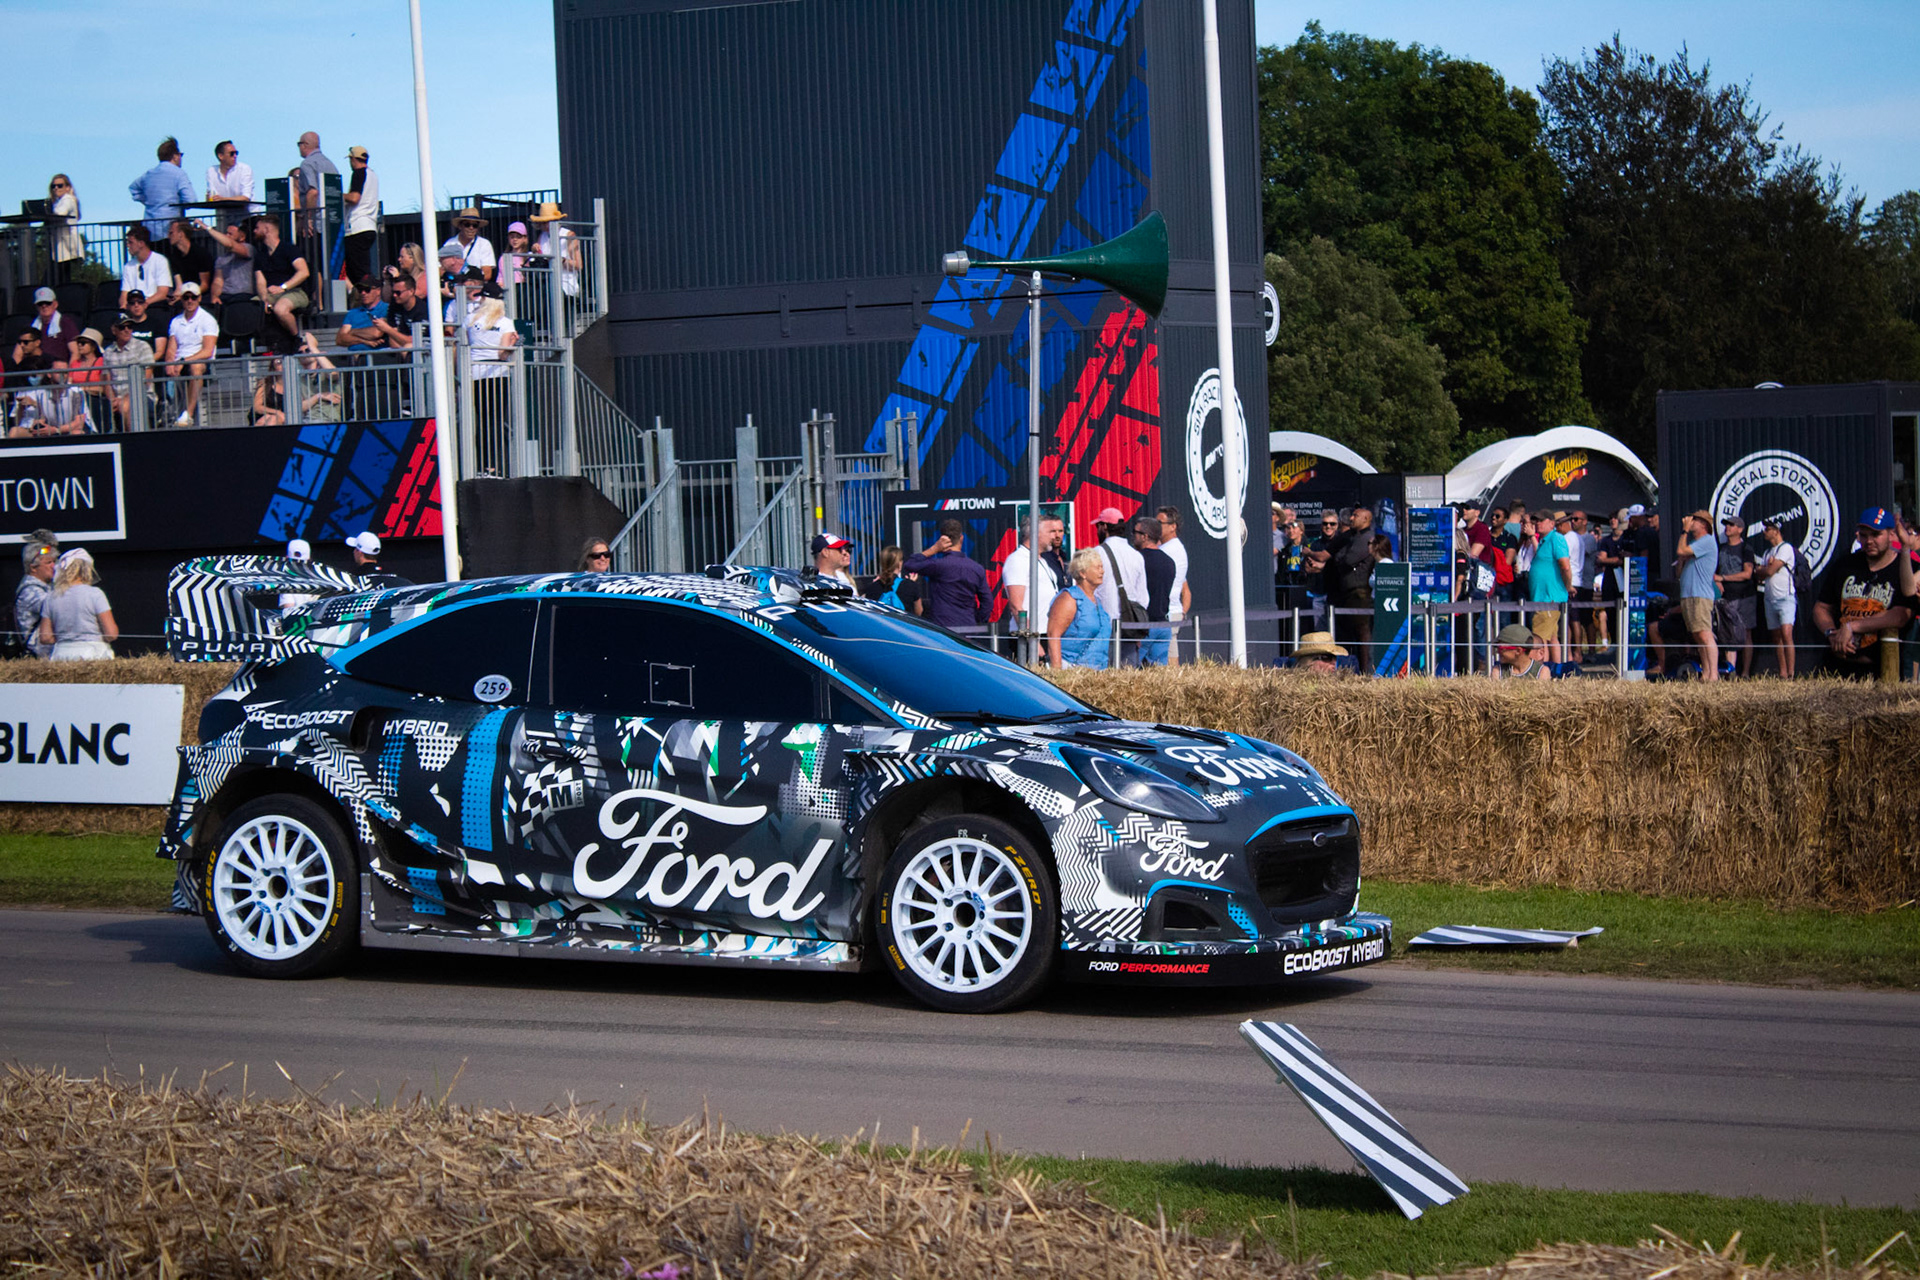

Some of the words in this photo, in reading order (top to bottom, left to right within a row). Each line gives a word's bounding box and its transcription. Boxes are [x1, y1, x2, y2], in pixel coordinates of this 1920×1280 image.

[0, 476, 94, 512] TOWN
[1722, 467, 1768, 520] ENERAL
[1771, 464, 1816, 498] STORE
[1803, 518, 1825, 558] TORE
[182, 642, 265, 653] PUMA
[480, 682, 507, 696] 259
[0, 721, 131, 766] BLANC
[382, 719, 449, 737] HYBRID
[1164, 745, 1307, 786] Ford
[573, 788, 834, 922] Ford
[1140, 834, 1229, 881] Ford
[1088, 961, 1120, 972] FORD
[1119, 962, 1211, 974] PERFORMANCE
[1352, 938, 1384, 963] HYBRID
